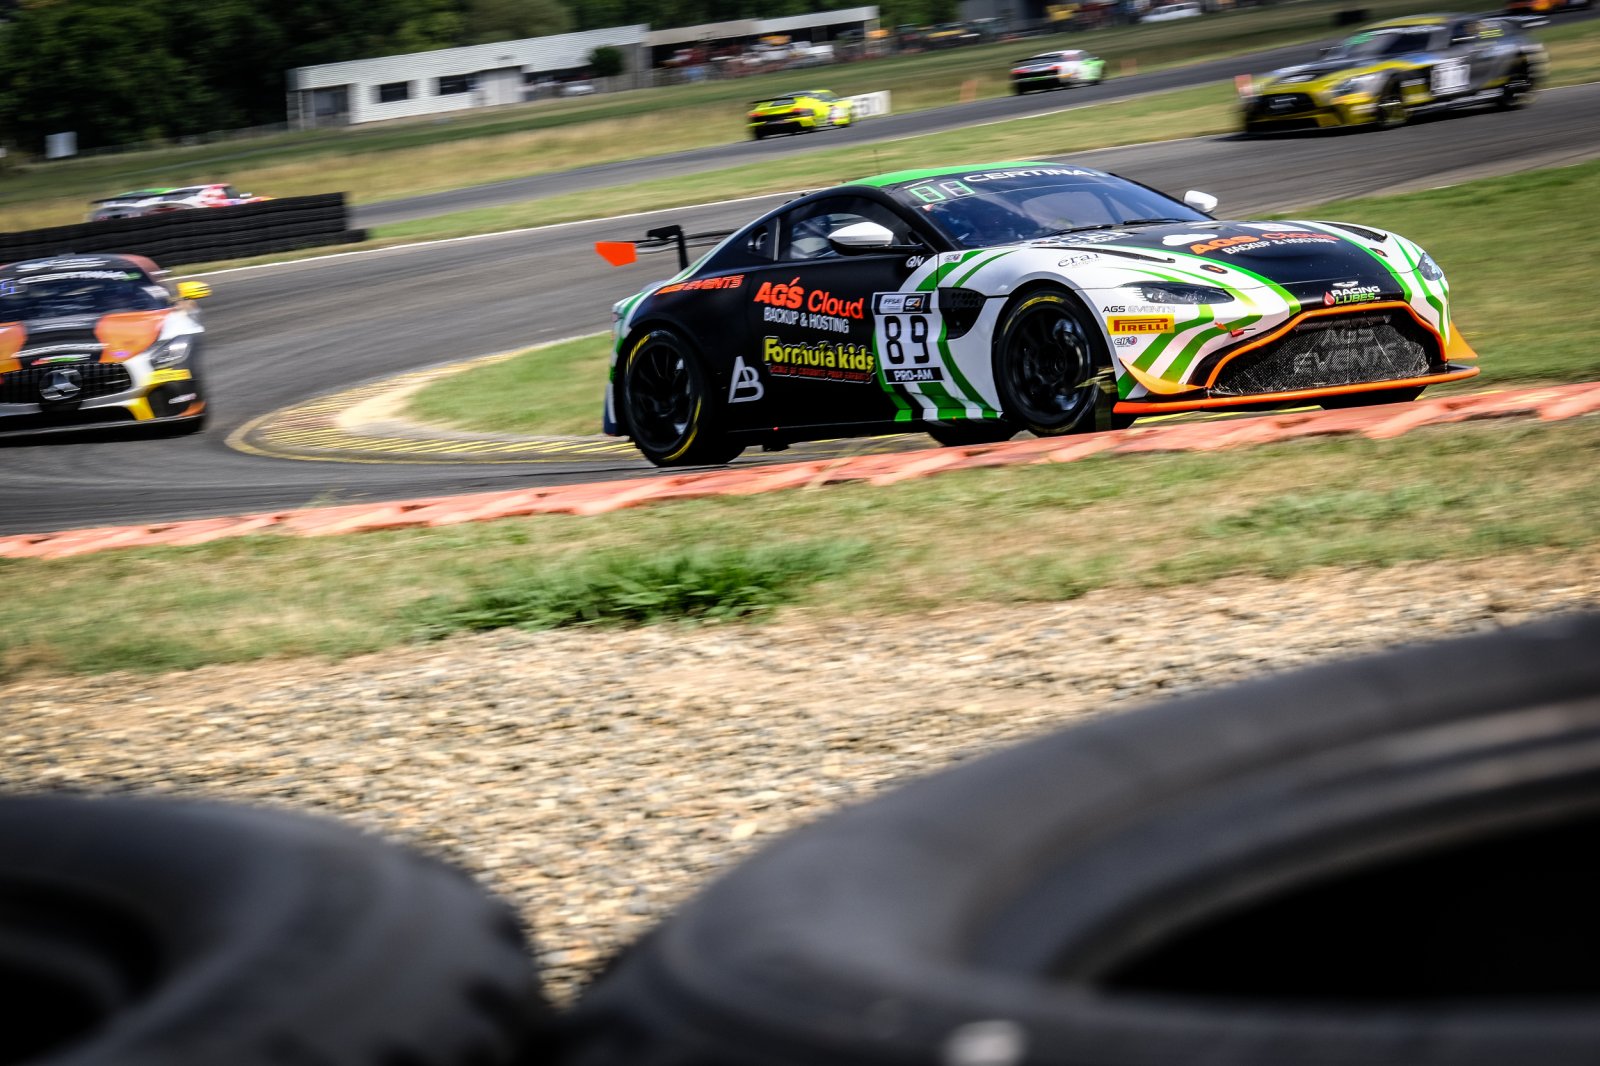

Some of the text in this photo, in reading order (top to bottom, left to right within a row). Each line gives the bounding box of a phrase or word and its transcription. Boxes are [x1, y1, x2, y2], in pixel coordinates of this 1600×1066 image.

[1331, 285, 1381, 297] RACING
[1335, 292, 1375, 305] LUBES
[807, 290, 864, 319] Cloud
[763, 307, 849, 333] BACKUP & HOSTING
[1113, 318, 1169, 332] PIRELLI
[884, 315, 929, 364] 89
[838, 345, 875, 374] kids
[893, 369, 933, 381] PRO-AM
